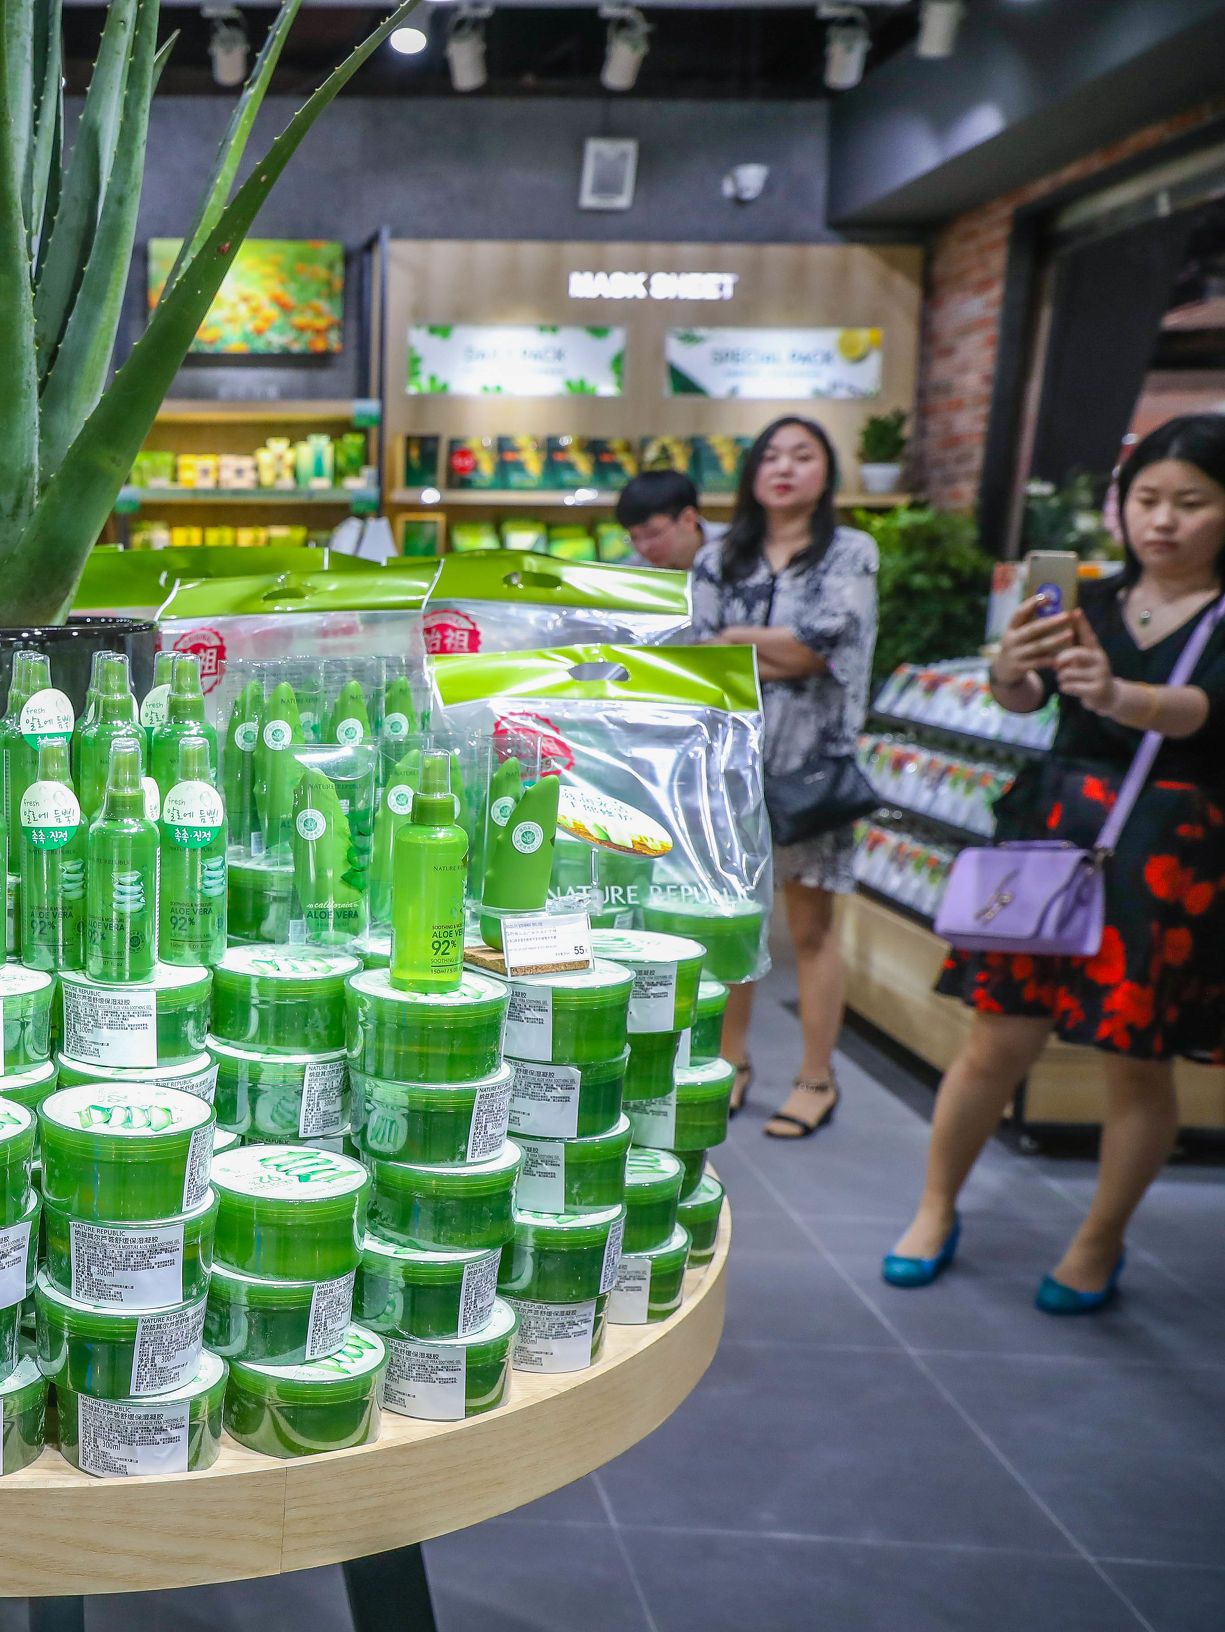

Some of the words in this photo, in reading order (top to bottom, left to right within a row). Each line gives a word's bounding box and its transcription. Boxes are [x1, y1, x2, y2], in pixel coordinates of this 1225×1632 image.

[569, 272, 648, 299] MASK
[650, 272, 737, 299] SHEET
[26, 707, 45, 715] fresh
[24, 799, 39, 807] fresh
[31, 911, 49, 919] ALOE
[51, 911, 73, 919] VERA
[307, 911, 332, 919] ALOE
[336, 911, 358, 919] VERA
[31, 920, 55, 935] 92%
[104, 922, 124, 931] VERA
[170, 916, 195, 931] 92%
[432, 930, 452, 938] ALOE
[432, 940, 456, 956] 92%
[78, 987, 101, 997] REPUBLIC
[73, 1223, 95, 1234] NATURE
[97, 1229, 125, 1237] REPUBLIC
[141, 1316, 164, 1324] NATURE
[166, 1312, 188, 1321] REPUBLIC
[81, 1395, 101, 1408] NATURE
[103, 1403, 131, 1413] REPUBLIC
